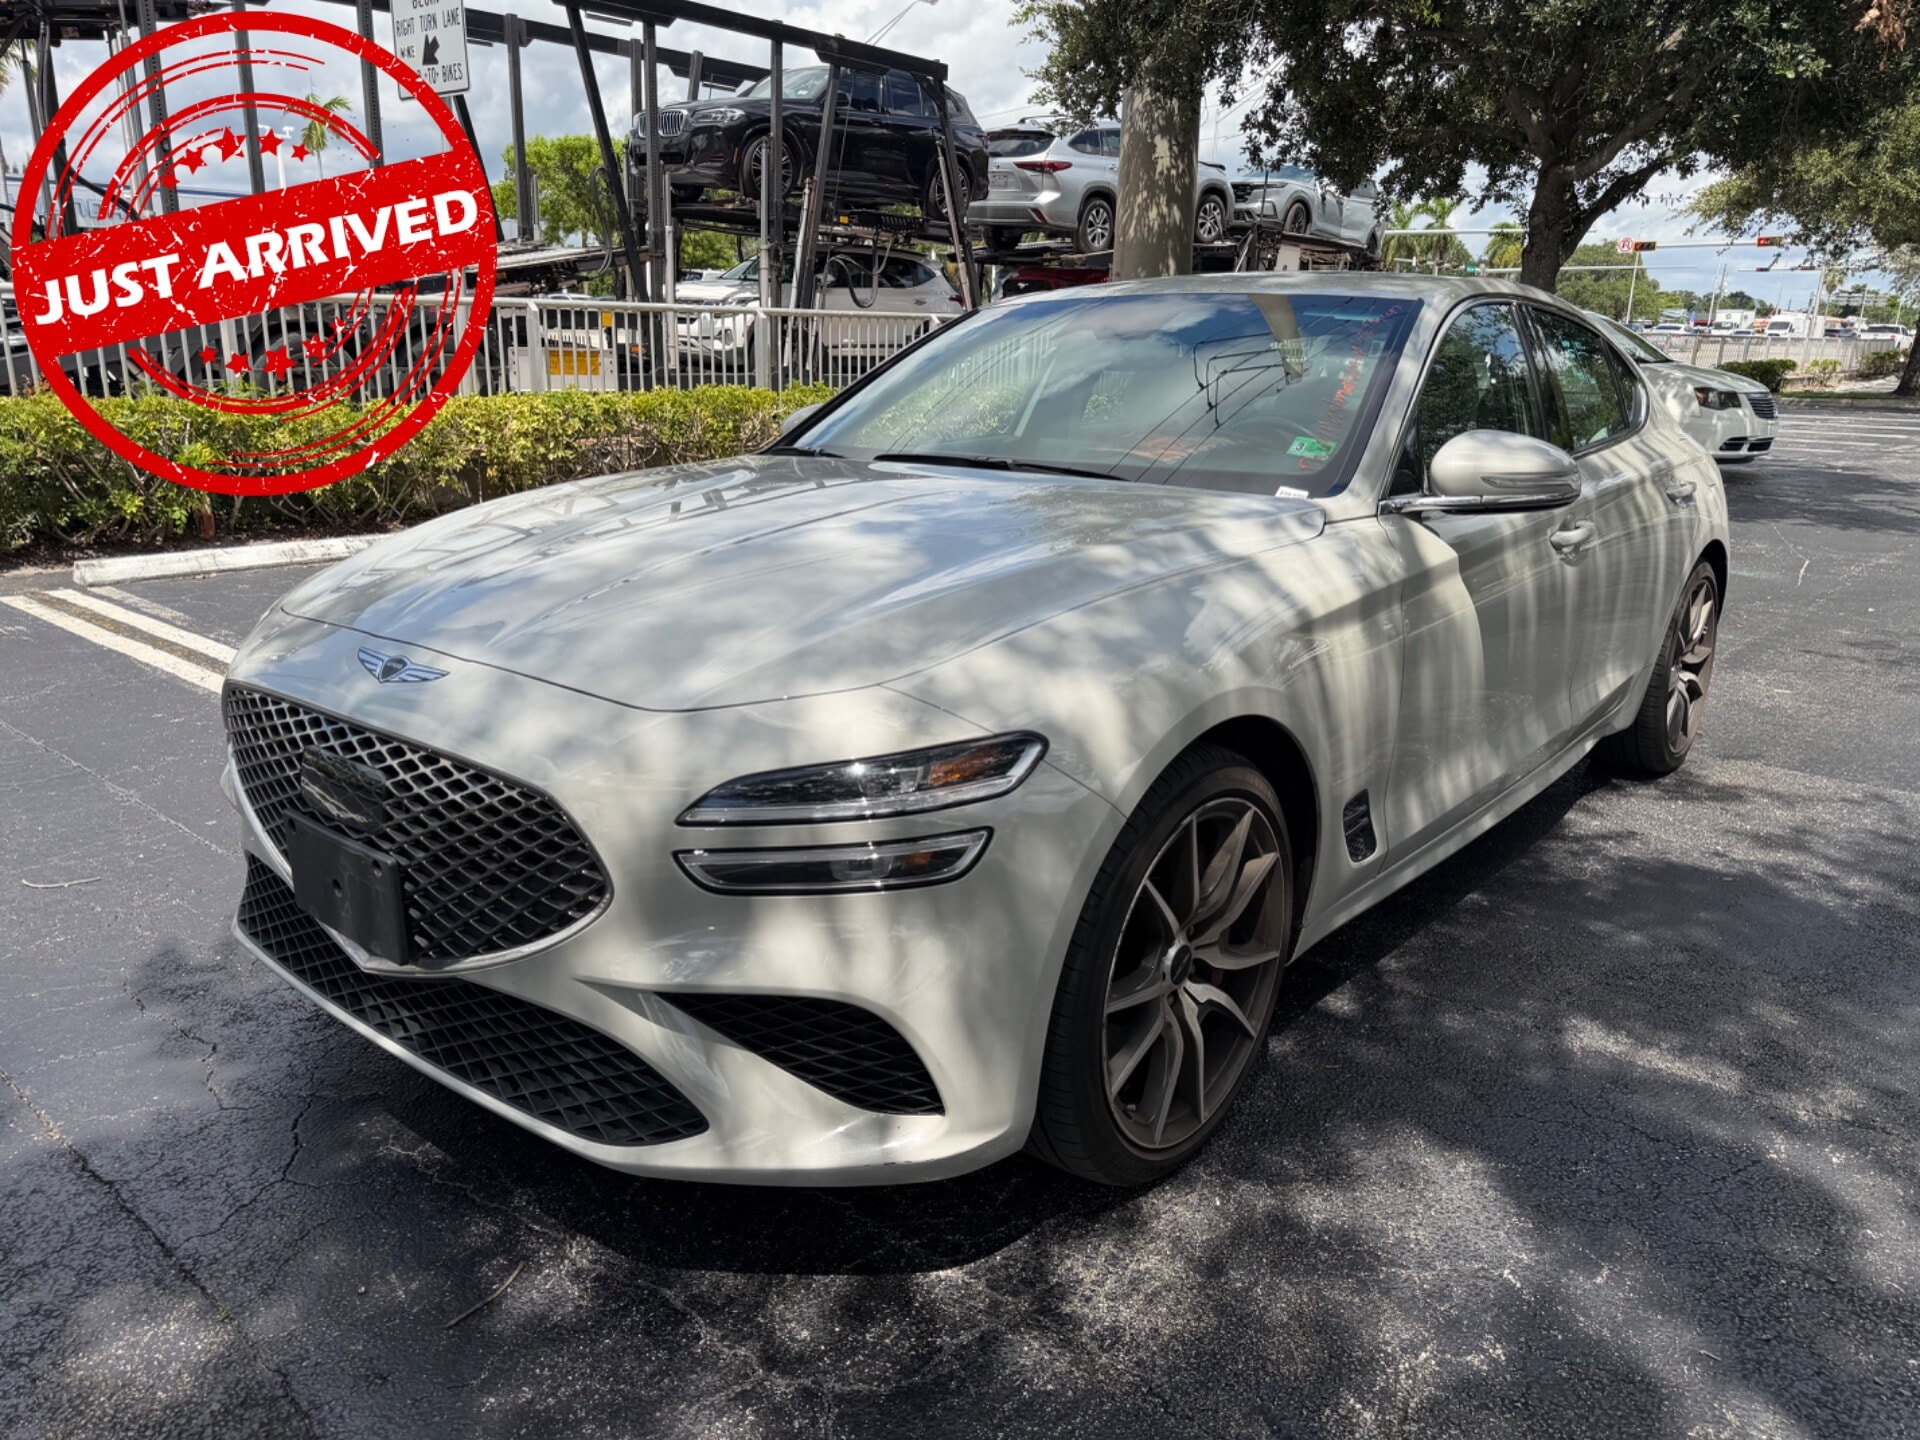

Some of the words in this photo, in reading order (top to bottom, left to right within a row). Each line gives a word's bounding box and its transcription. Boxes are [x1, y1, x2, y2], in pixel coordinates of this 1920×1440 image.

[396, 17, 415, 37] RIGHT
[419, 12, 438, 33] TURN
[442, 8, 461, 28] LANE
[442, 63, 463, 82] BIKES
